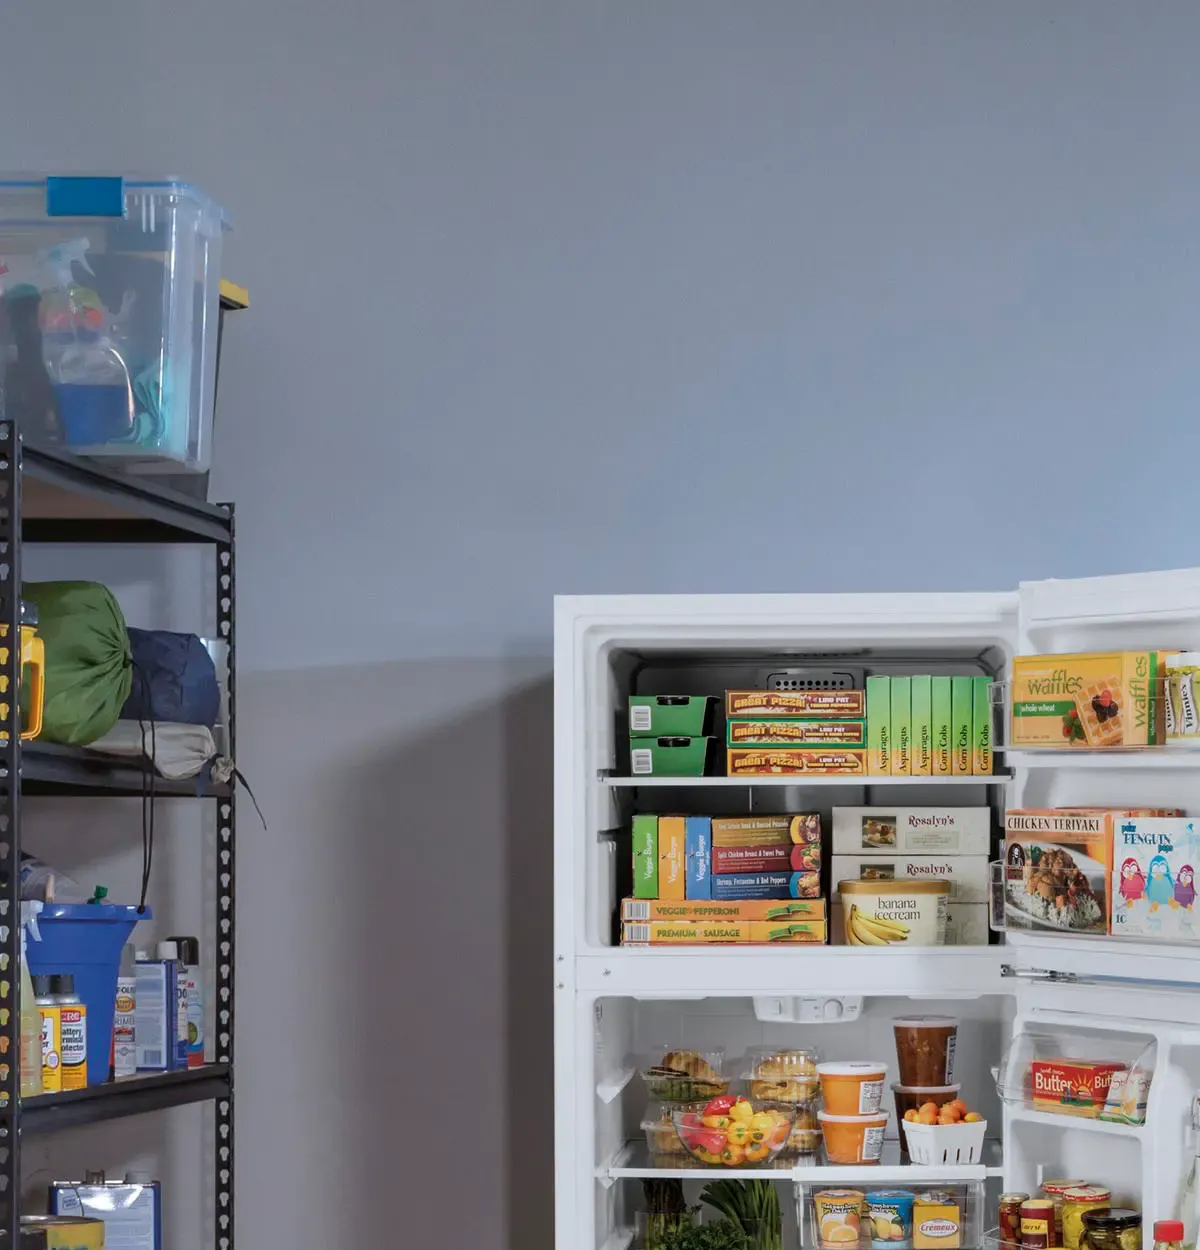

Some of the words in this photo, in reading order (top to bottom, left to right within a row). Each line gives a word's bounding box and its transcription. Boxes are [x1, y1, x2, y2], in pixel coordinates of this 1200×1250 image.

[1027, 669, 1083, 695] waffles
[1129, 656, 1148, 729] waffles
[734, 697, 769, 709] GREAT
[939, 724, 947, 747] Cobs
[959, 724, 967, 747] Cobs
[980, 724, 989, 747] Cobs
[880, 726, 888, 771] Asparagus
[900, 726, 909, 771] Asparagus
[920, 725, 930, 771] Asparagus
[939, 749, 947, 771] Corn
[959, 749, 967, 771] Corn
[980, 749, 989, 771] Corn
[908, 815, 955, 828] Rosalyn's
[1007, 817, 1050, 830] CHICKEN
[1053, 819, 1100, 831] TERIYAKI
[906, 863, 953, 876] Rosalyn's
[693, 907, 740, 916] PEPPERONI
[878, 897, 917, 909] banana
[874, 909, 921, 921] icecream
[657, 929, 697, 938] PREMIUM
[703, 929, 741, 938] SAUSAGE
[61, 1028, 82, 1038] attery
[1035, 1072, 1072, 1092] Butter
